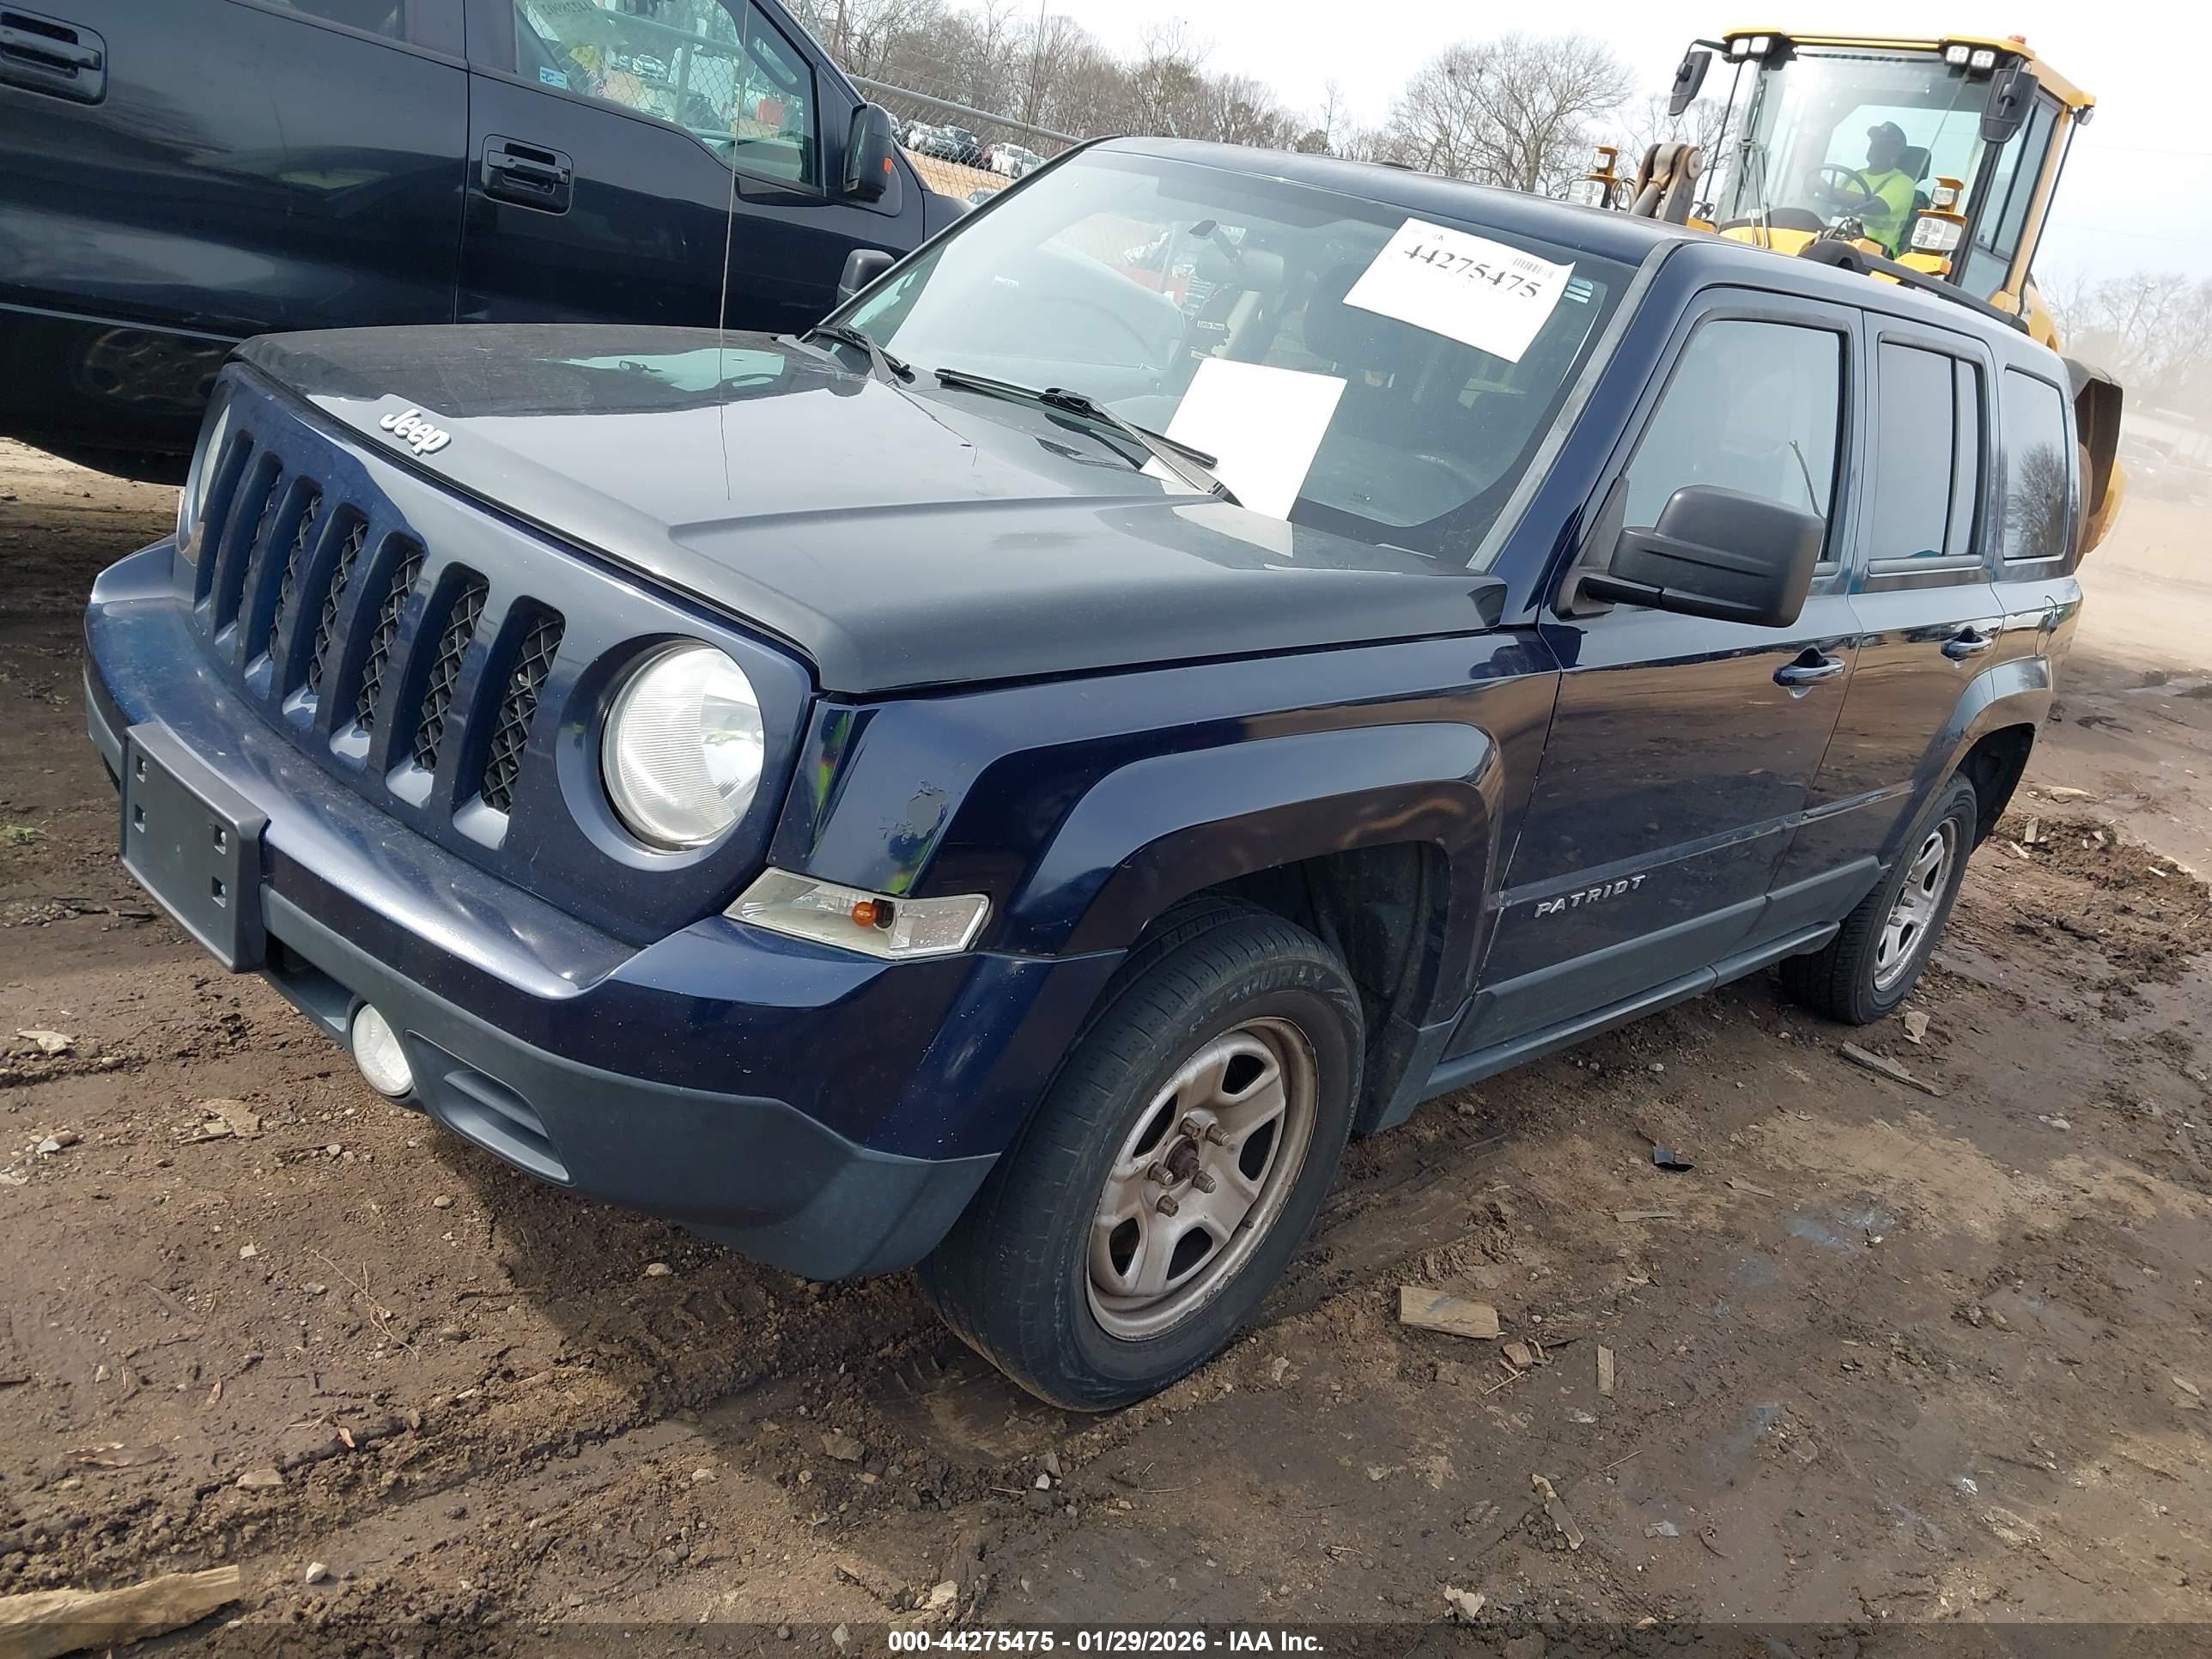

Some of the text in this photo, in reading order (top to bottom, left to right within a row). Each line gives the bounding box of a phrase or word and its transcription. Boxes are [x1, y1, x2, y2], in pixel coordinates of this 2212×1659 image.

[1404, 245, 1542, 298] 44275475
[380, 408, 452, 457] Jeep
[1534, 874, 1646, 918] PATRIOT
